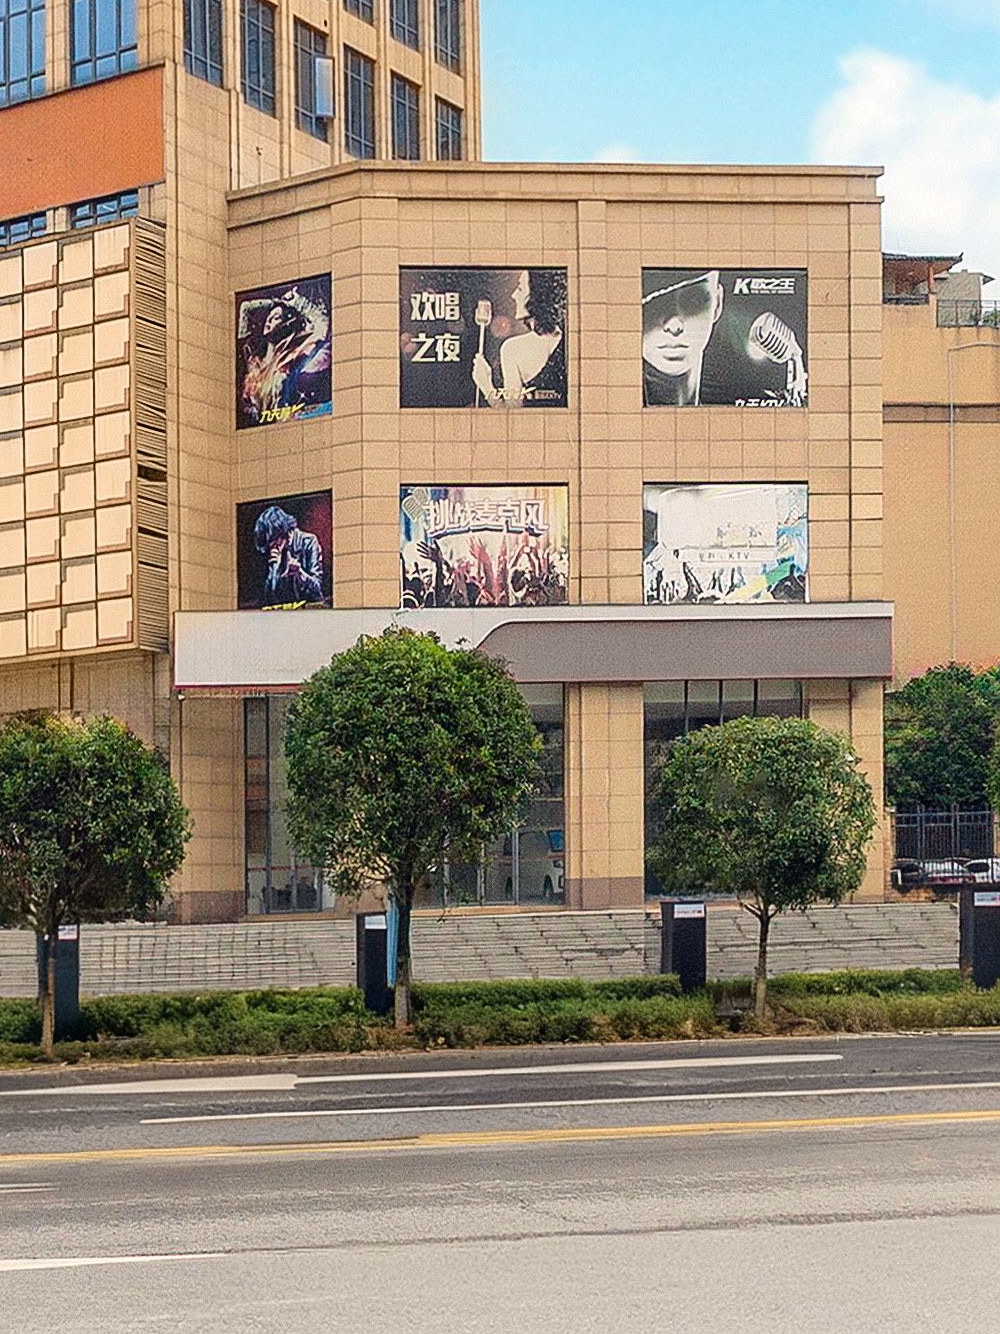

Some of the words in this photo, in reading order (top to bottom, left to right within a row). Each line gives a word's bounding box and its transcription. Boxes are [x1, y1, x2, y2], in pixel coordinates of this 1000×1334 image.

[410, 292, 461, 322] 欢唱
[410, 332, 461, 363] 之夜
[421, 497, 550, 537] 挑战麦克风
